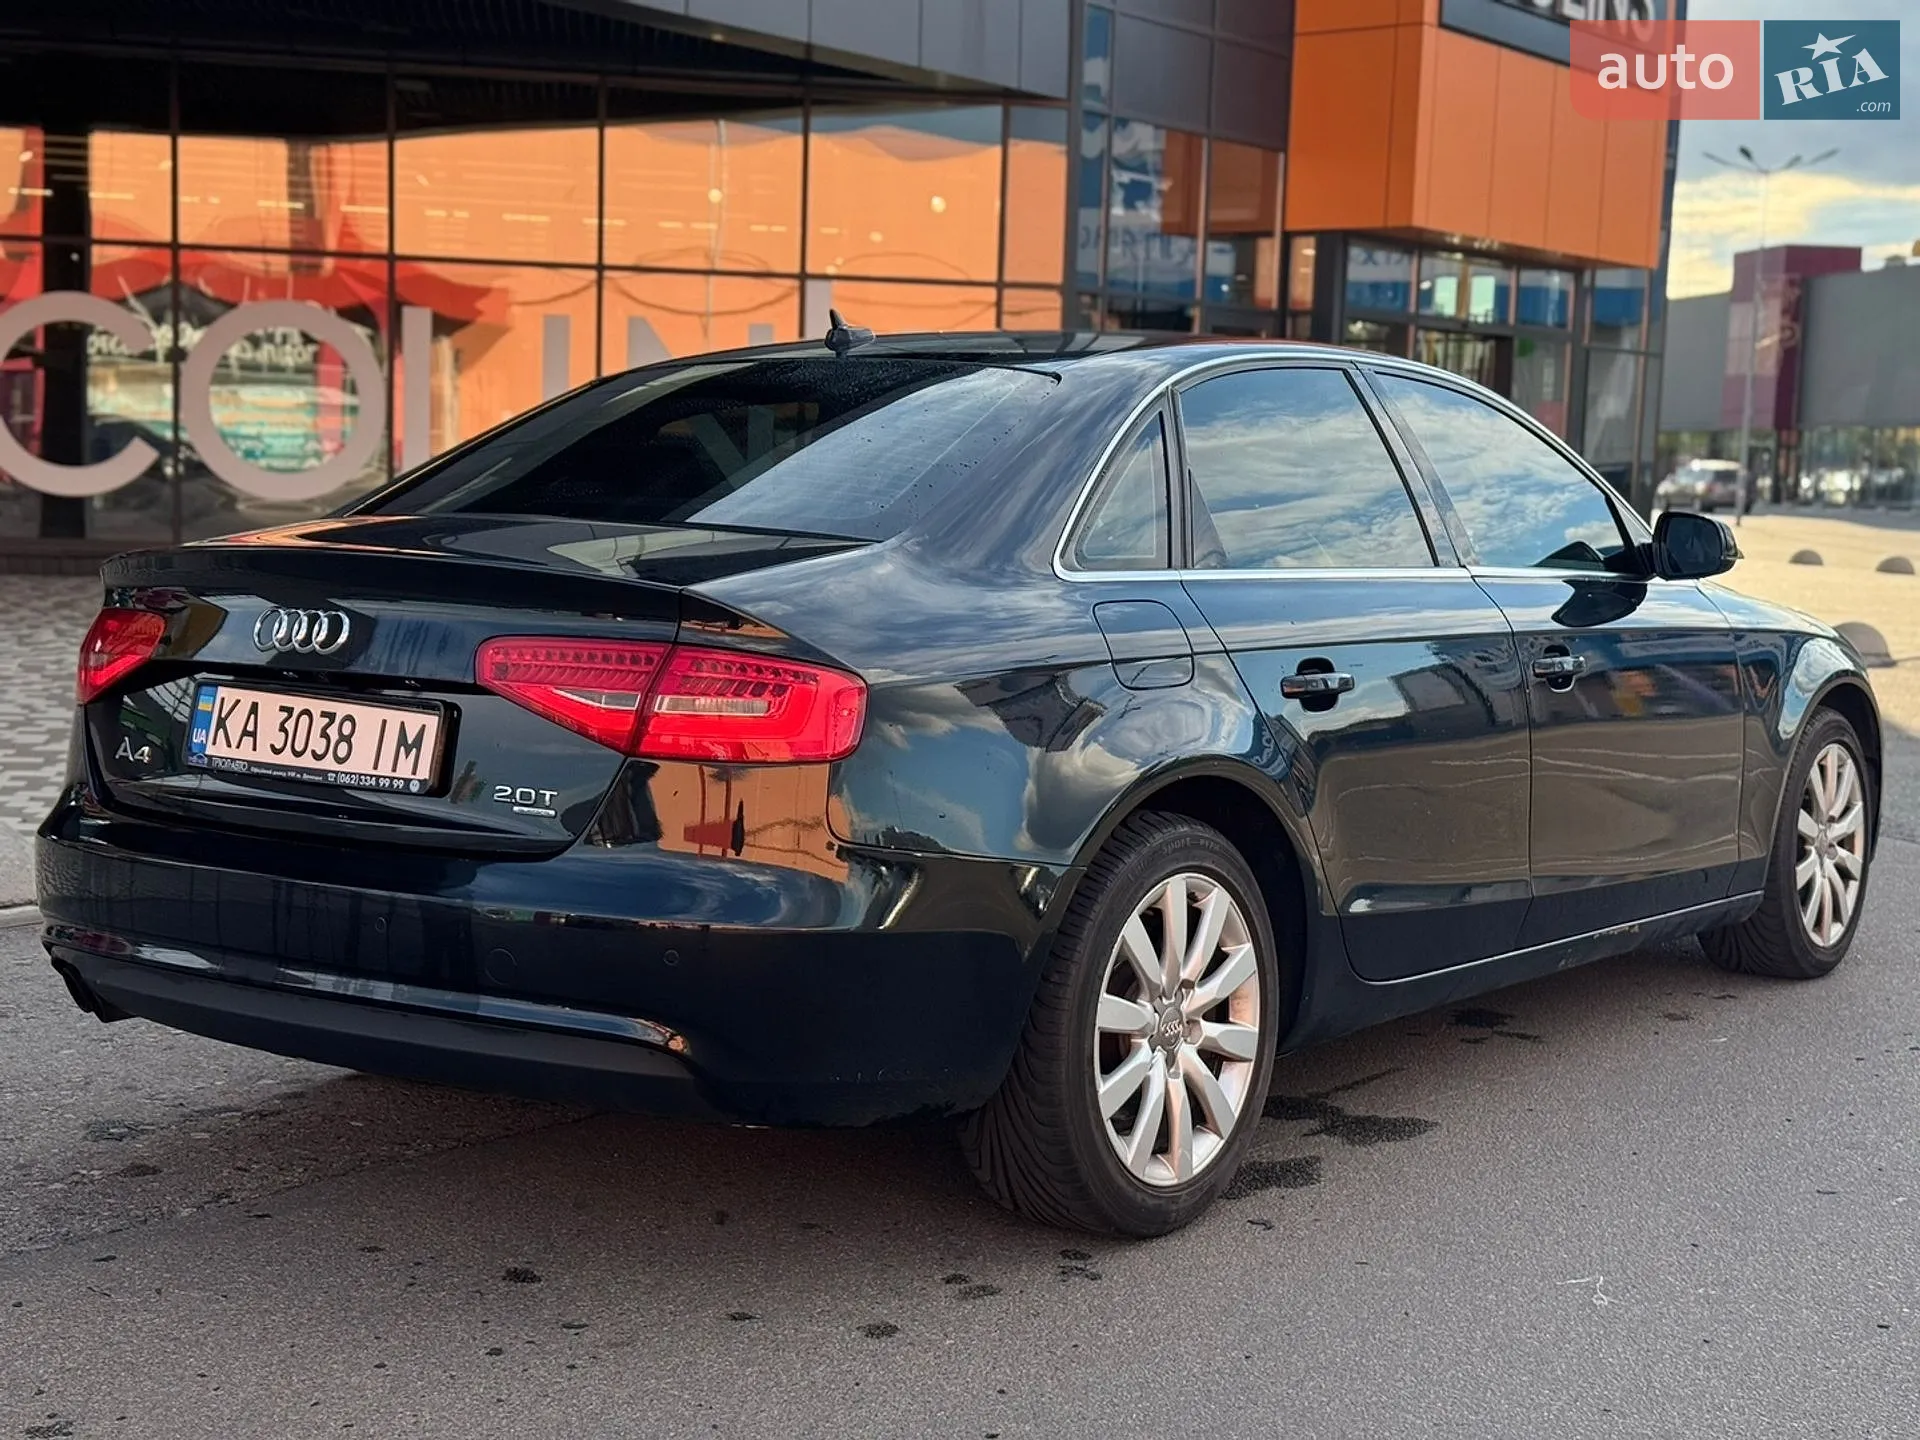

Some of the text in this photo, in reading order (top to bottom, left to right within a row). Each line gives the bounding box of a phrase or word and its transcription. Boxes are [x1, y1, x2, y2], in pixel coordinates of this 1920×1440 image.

[192, 728, 206, 744] UA
[211, 696, 426, 776] KA 3038 IM
[115, 736, 151, 764] A4
[337, 772, 404, 789] (062) 334 99 99
[493, 785, 558, 807] 2.0T
